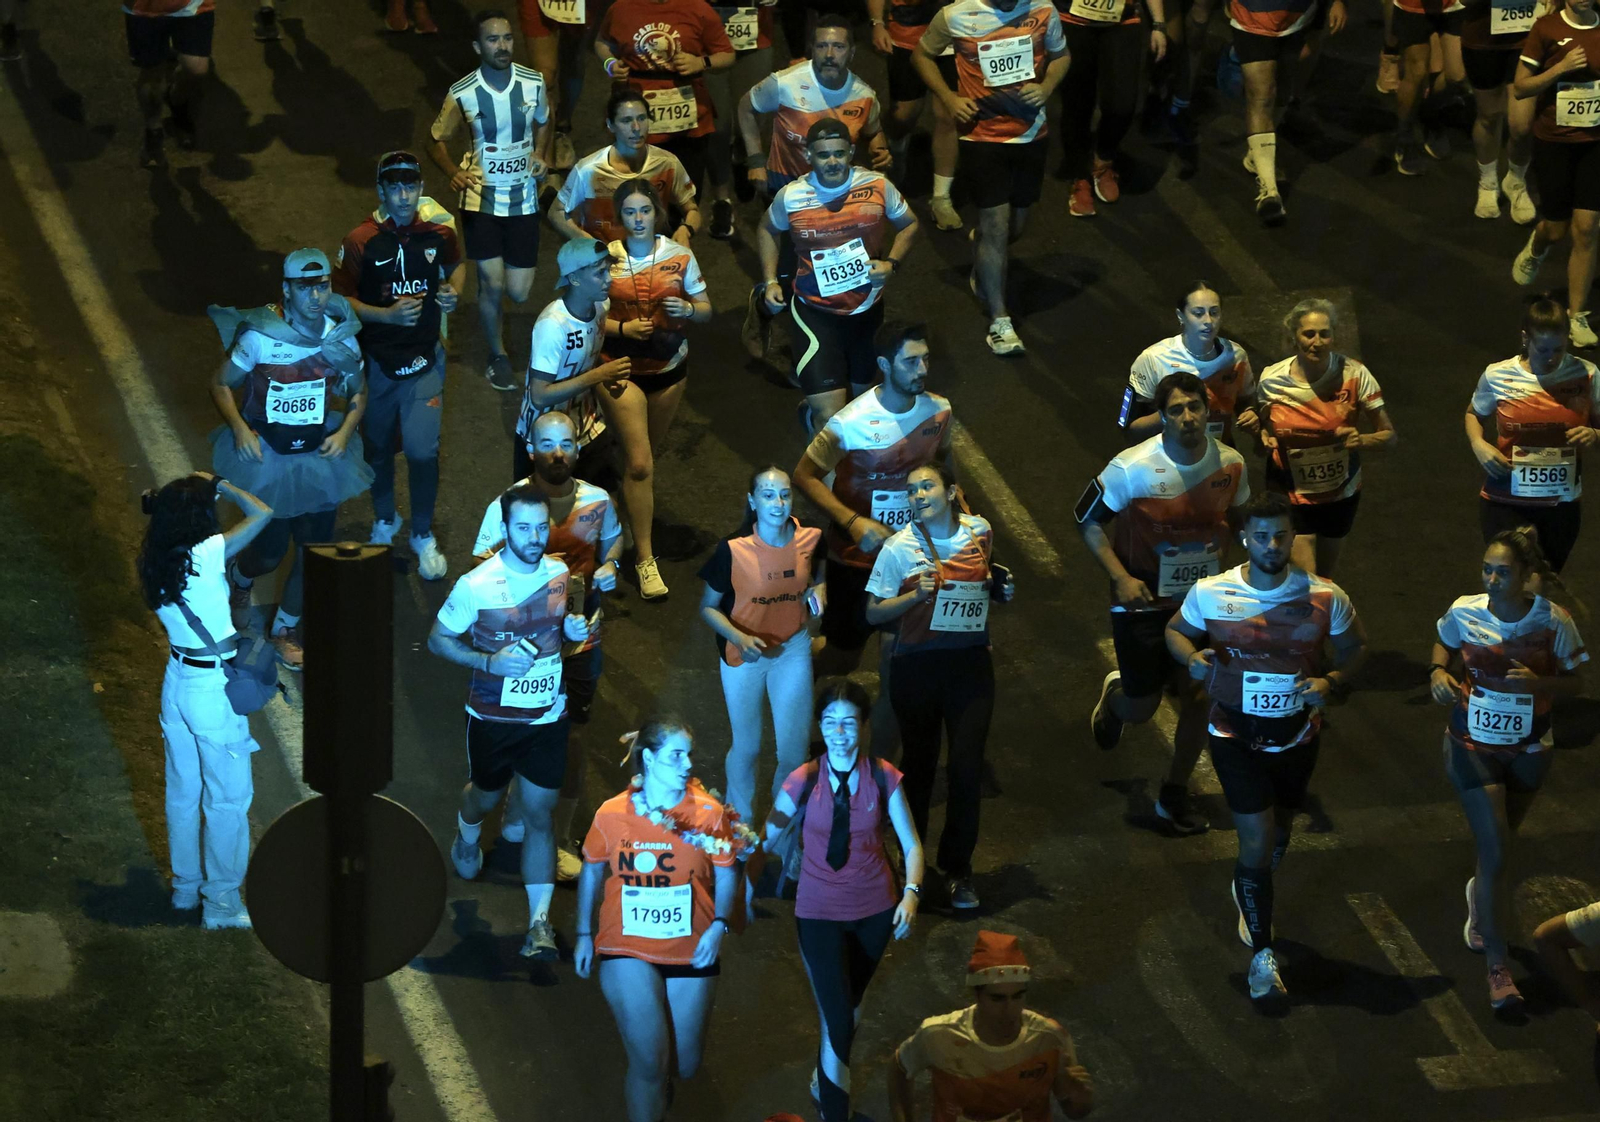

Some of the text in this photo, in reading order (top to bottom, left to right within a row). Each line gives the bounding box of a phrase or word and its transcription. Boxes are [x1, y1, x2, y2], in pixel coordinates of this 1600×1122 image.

[1501, 5, 1534, 21] 2658
[989, 55, 1021, 73] 9807
[650, 104, 690, 121] 17192
[1567, 100, 1600, 115] 2672
[488, 157, 527, 175] 24529
[821, 259, 865, 282] 16338
[391, 279, 428, 295] NAGA
[566, 330, 584, 351] 55
[395, 359, 429, 377] ellesse
[272, 397, 316, 413] 20686
[1298, 461, 1344, 480] 14355
[1519, 467, 1568, 482] 15569
[1171, 564, 1208, 582] 4096
[942, 601, 984, 617] 17186
[510, 676, 555, 694] 20993
[1250, 691, 1300, 709] 13277
[1474, 709, 1522, 731] 13278
[633, 841, 673, 850] CARRERA
[618, 851, 676, 873] NOC
[1240, 878, 1261, 932] kalenji
[631, 907, 683, 924] 17995
